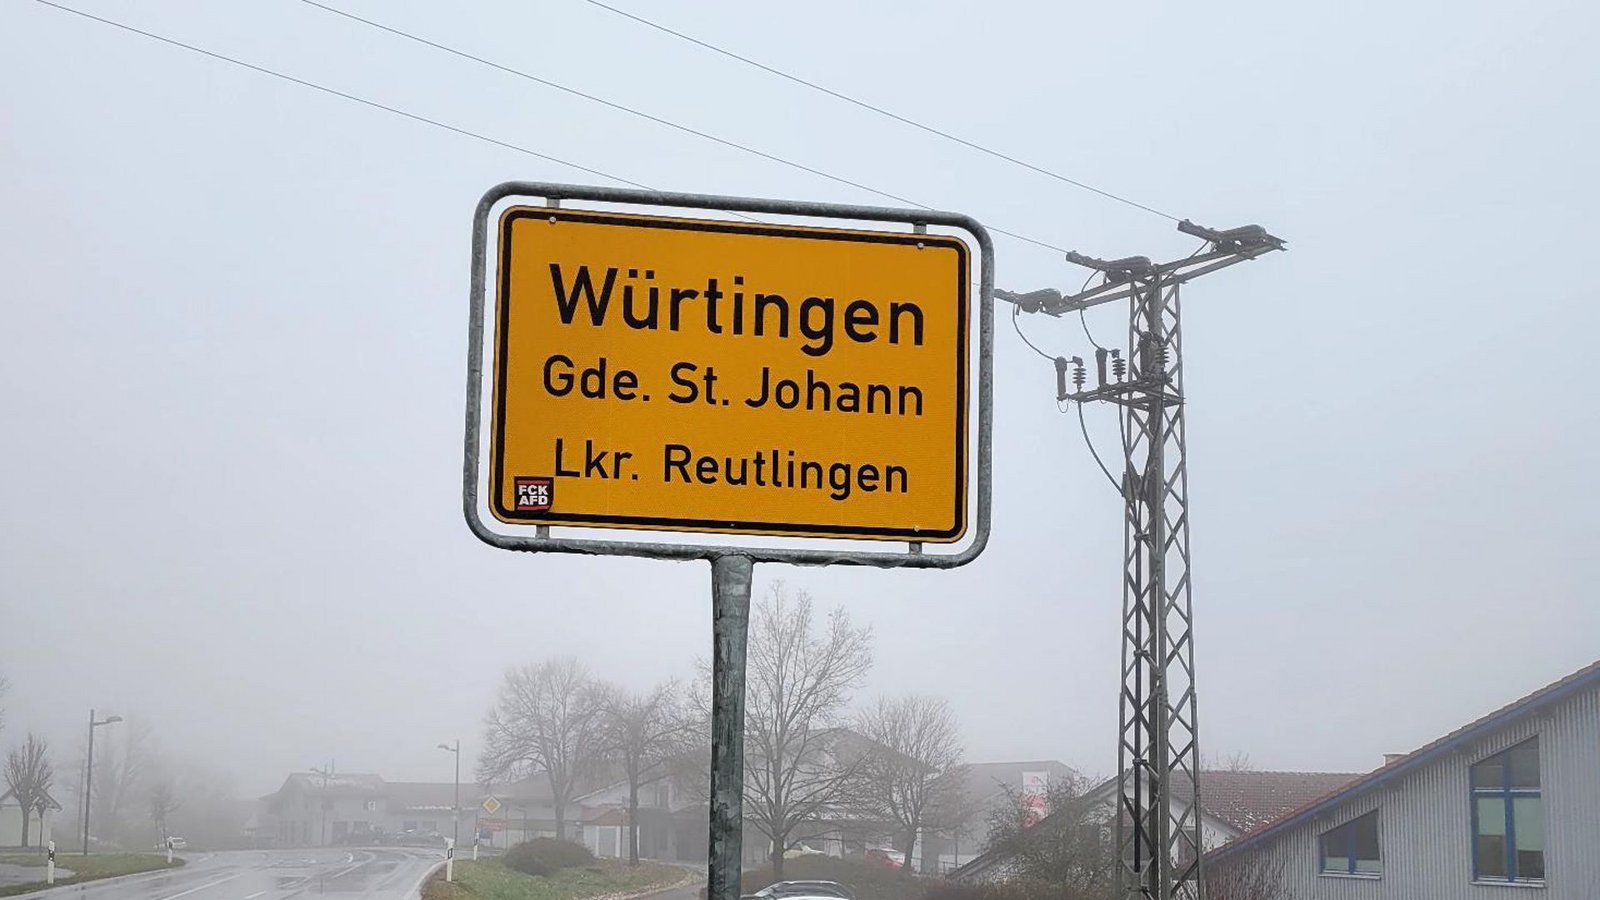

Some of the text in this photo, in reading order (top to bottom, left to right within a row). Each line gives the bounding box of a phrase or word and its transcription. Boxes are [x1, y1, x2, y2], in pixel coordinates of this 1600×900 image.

[549, 263, 924, 357] Würtingen
[543, 354, 923, 416] Gde. St. Johann
[518, 485, 548, 495] FCK
[518, 495, 548, 505] AFD
[555, 438, 908, 501] Lkr. Reutlingen
